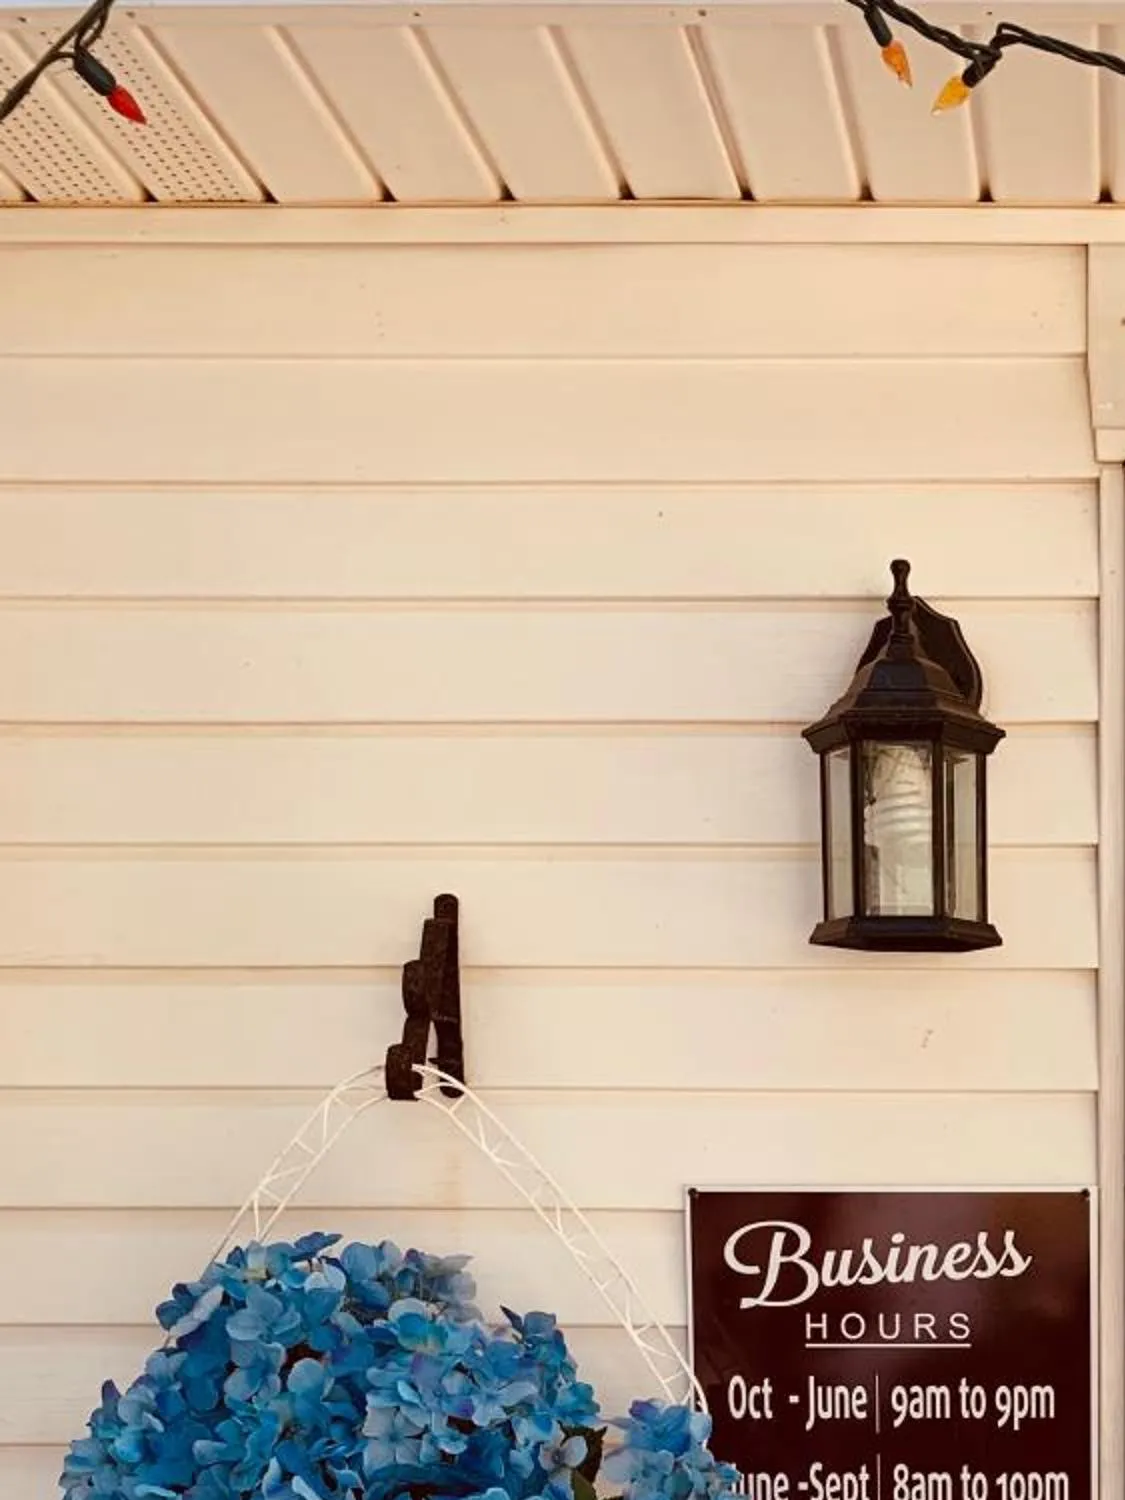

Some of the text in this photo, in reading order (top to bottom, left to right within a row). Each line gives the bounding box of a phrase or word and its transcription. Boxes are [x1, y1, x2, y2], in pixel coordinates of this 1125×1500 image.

[724, 1221, 1033, 1309] Business
[805, 1313, 971, 1340] HOURS
[728, 1375, 773, 1420] Oct
[806, 1375, 869, 1432] June
[891, 1385, 952, 1429] 9am
[959, 1377, 988, 1420] to
[995, 1385, 1056, 1432] 9pm
